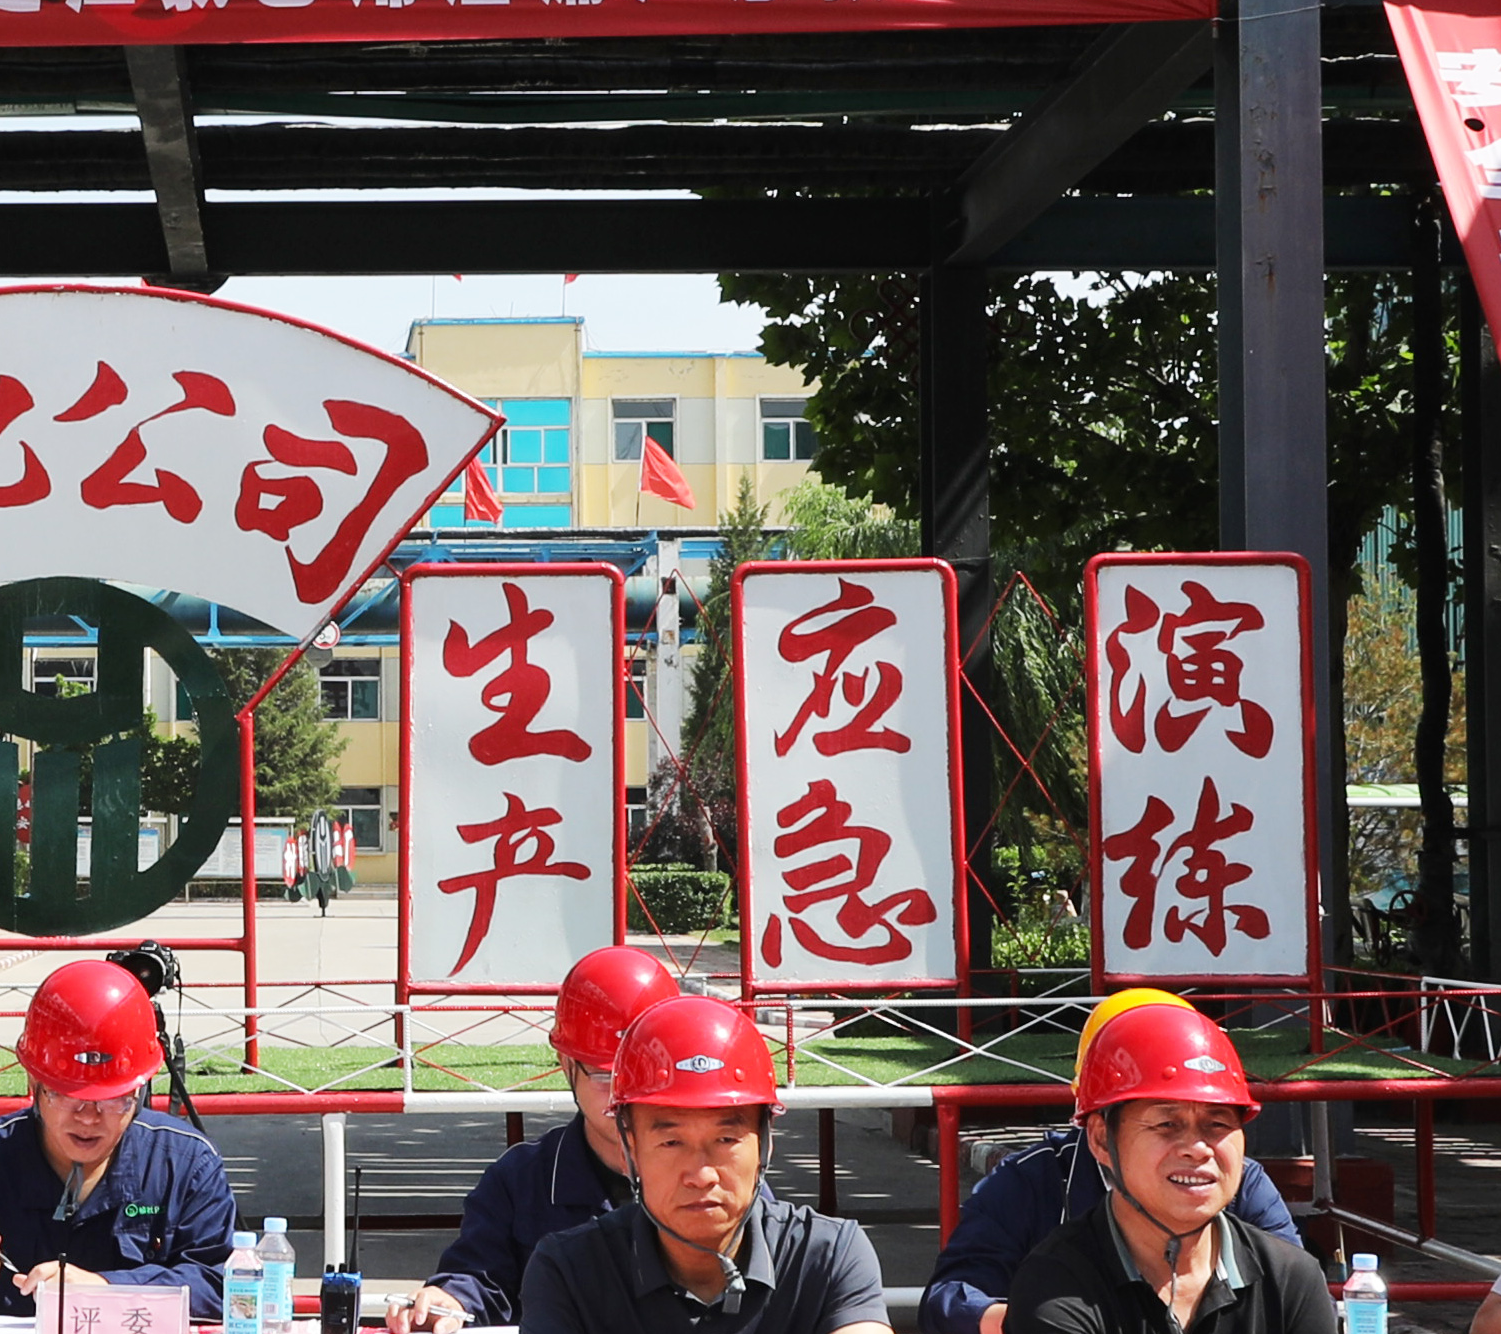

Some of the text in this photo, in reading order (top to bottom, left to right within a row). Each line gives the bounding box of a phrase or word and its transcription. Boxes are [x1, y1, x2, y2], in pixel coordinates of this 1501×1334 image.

[438, 582, 592, 978] 生产
[761, 580, 937, 966] 应急
[1102, 581, 1274, 958] 演练
